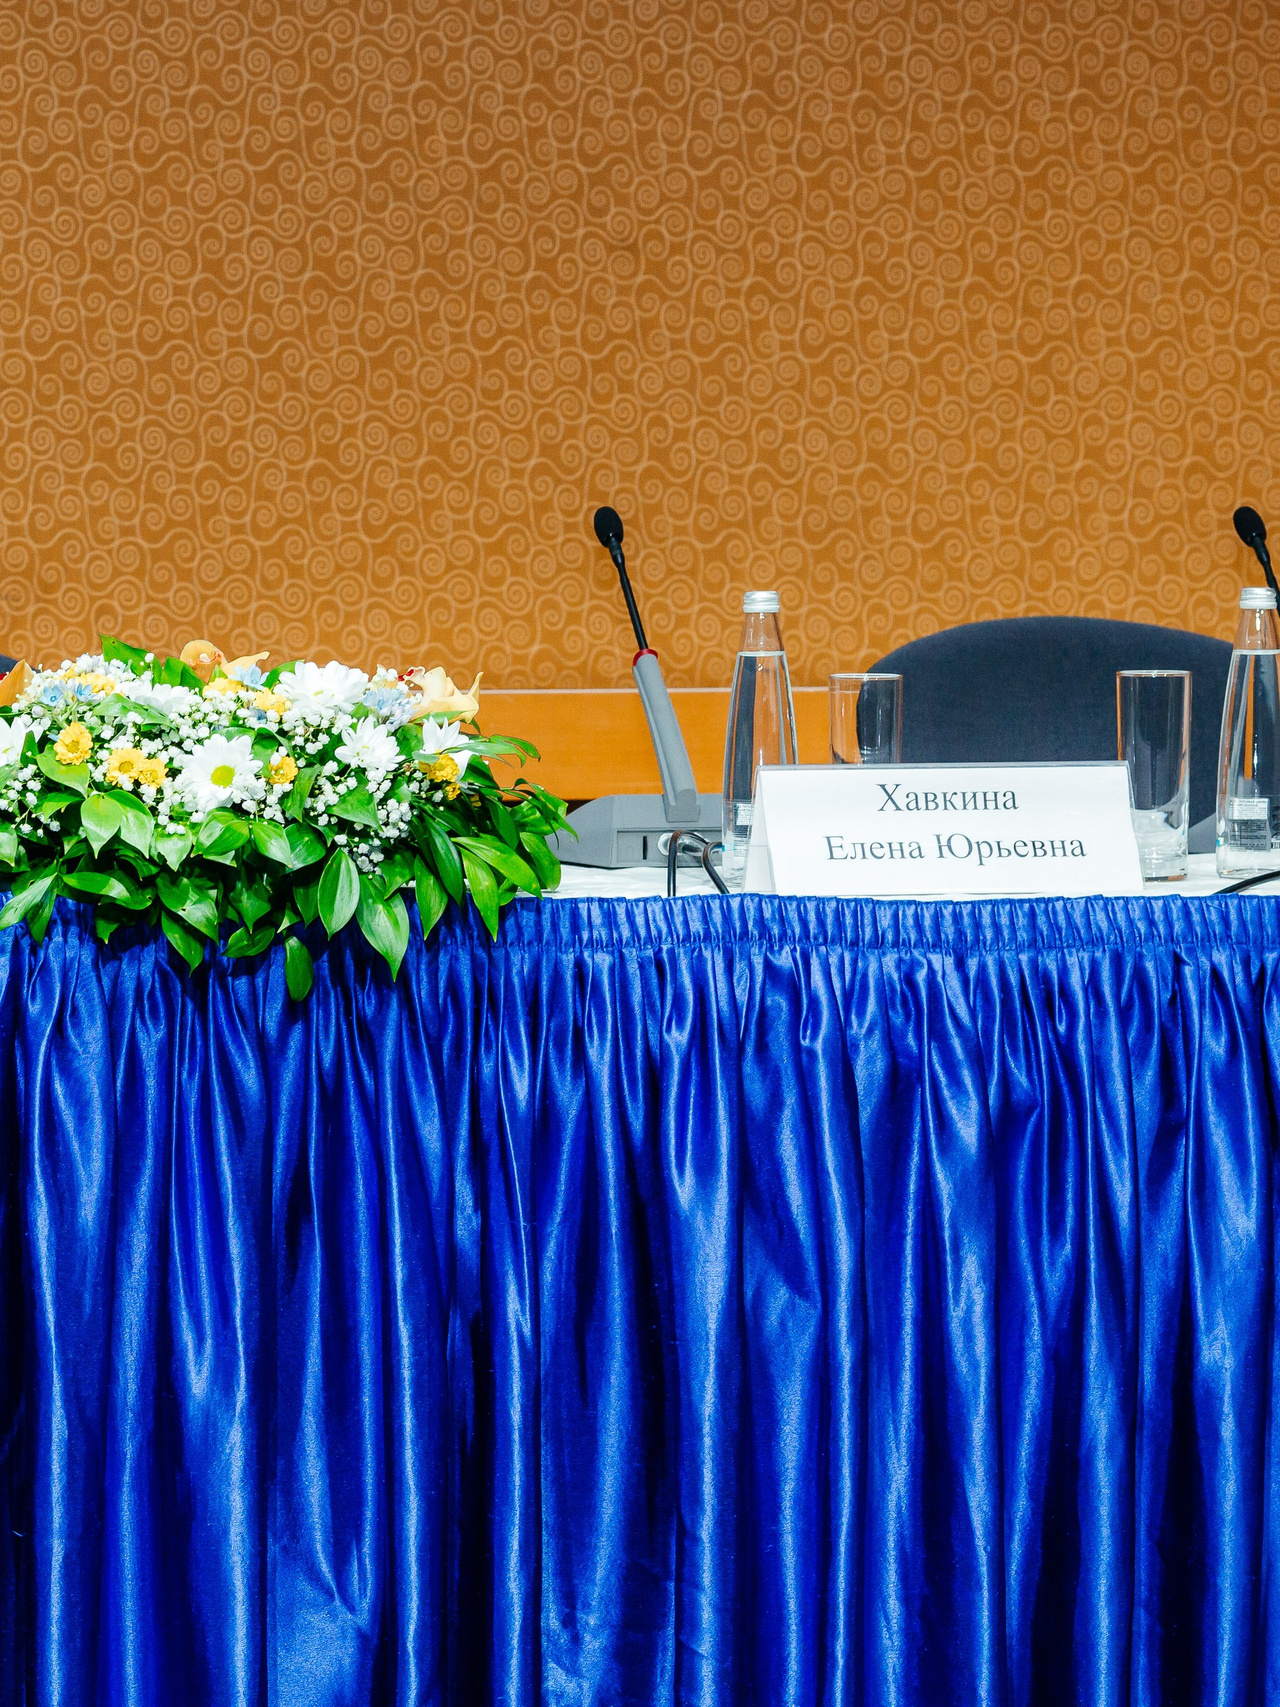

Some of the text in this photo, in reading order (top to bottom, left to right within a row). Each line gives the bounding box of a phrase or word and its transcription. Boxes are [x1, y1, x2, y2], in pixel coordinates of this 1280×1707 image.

[876, 784, 1019, 811] Хавкина
[826, 834, 1087, 866] Елена Юрьевна
